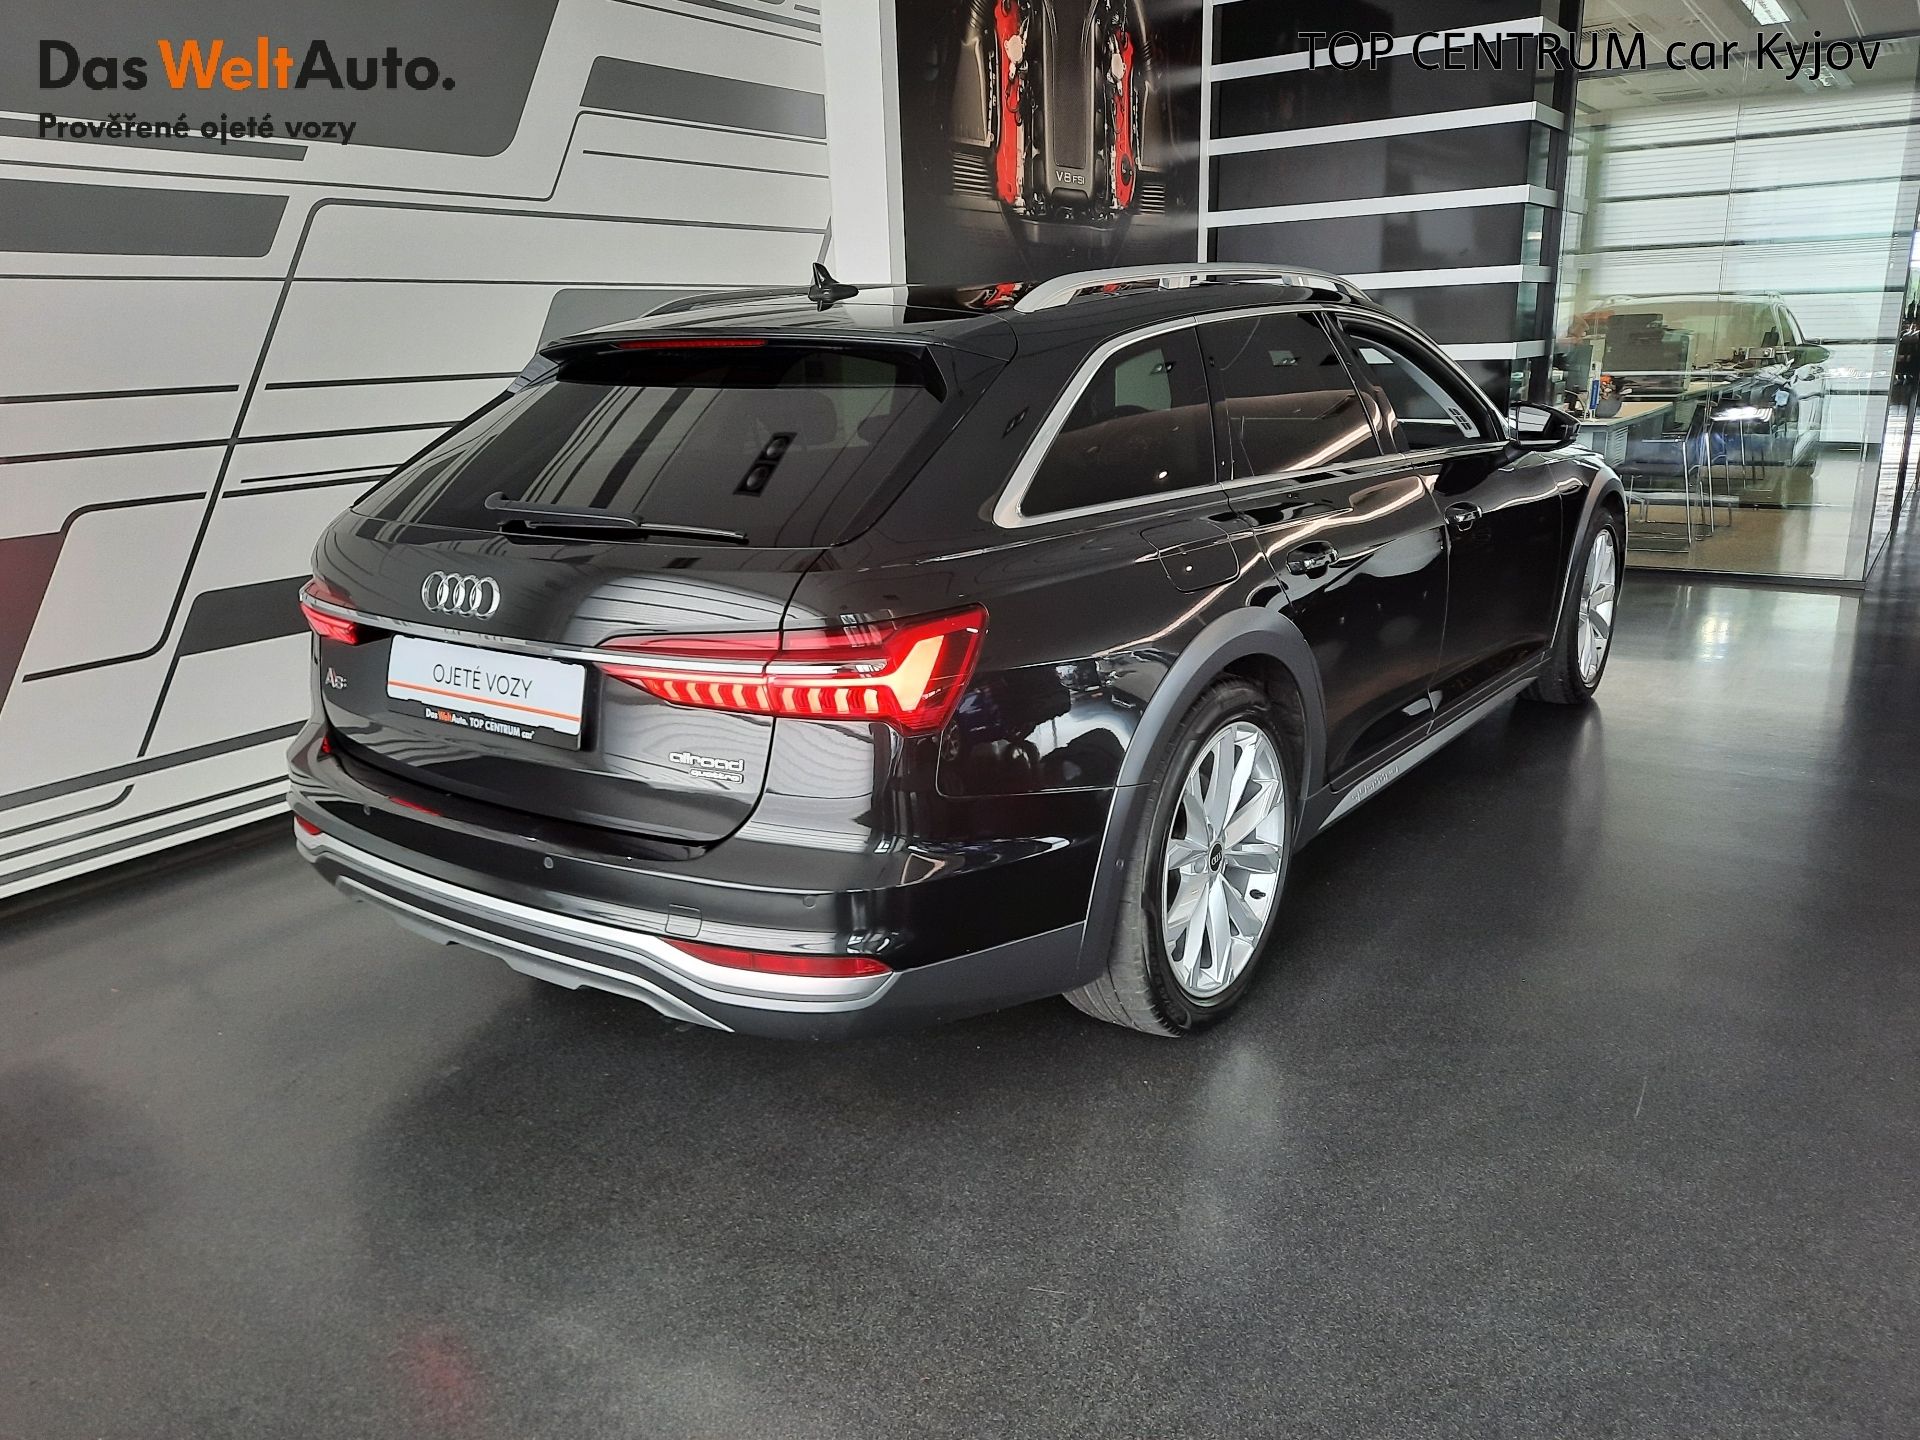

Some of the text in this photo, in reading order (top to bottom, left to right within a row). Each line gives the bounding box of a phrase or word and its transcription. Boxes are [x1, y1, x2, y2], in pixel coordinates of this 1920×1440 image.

[433, 664, 533, 699] OJETÉ VOZY
[469, 717, 485, 729] TOP
[484, 720, 521, 738] CENTRUM
[669, 752, 744, 772] allroad
